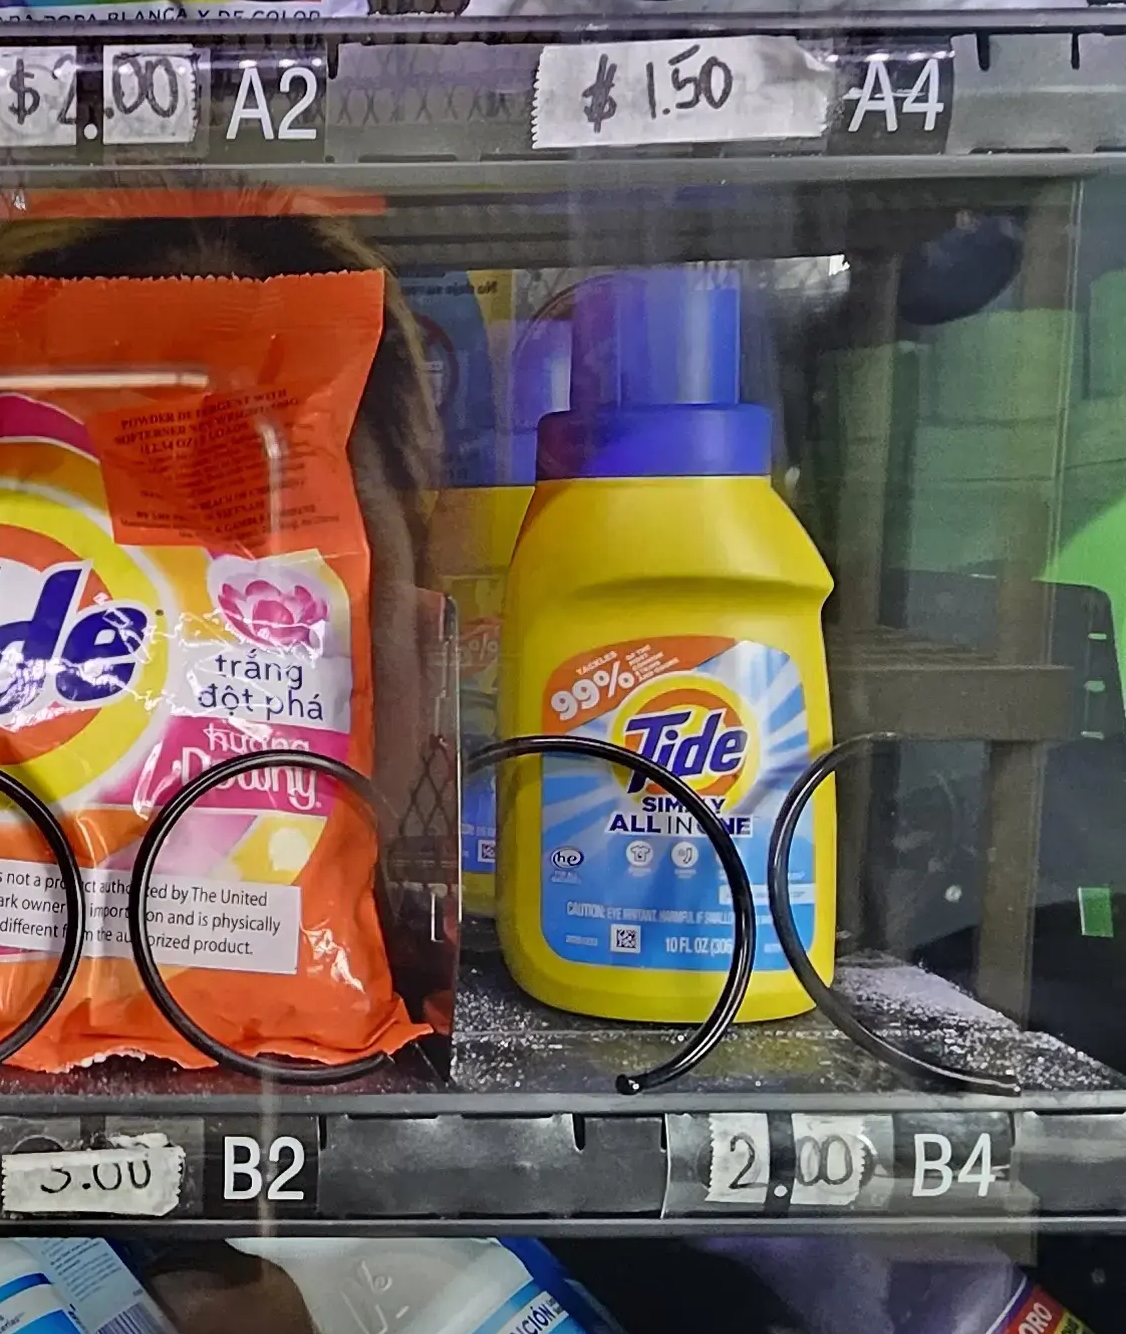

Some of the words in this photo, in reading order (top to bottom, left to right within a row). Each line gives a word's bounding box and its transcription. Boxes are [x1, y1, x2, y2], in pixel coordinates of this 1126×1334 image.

[225, 65, 318, 141] A2
[847, 58, 944, 132] A4
[197, 682, 254, 717] đột
[265, 688, 324, 722] phá
[550, 660, 635, 721] 99%
[181, 745, 320, 811] Dwny
[624, 707, 749, 795] Tide
[608, 813, 662, 834] ALL
[667, 815, 692, 835] IN
[642, 794, 727, 815] SIMY
[6, 871, 31, 887] not
[33, 874, 42, 888] a
[171, 884, 189, 904] by
[191, 886, 217, 903] The
[220, 889, 268, 907] United
[21, 898, 66, 914] owner
[167, 910, 195, 926] and
[198, 912, 209, 927] is
[211, 913, 281, 937] physically
[0, 917, 59, 939] different
[97, 927, 113, 942] the
[115, 930, 190, 950] auorized
[192, 937, 254, 956] product.
[222, 1136, 306, 1201] B2
[912, 1131, 998, 1198] B4
